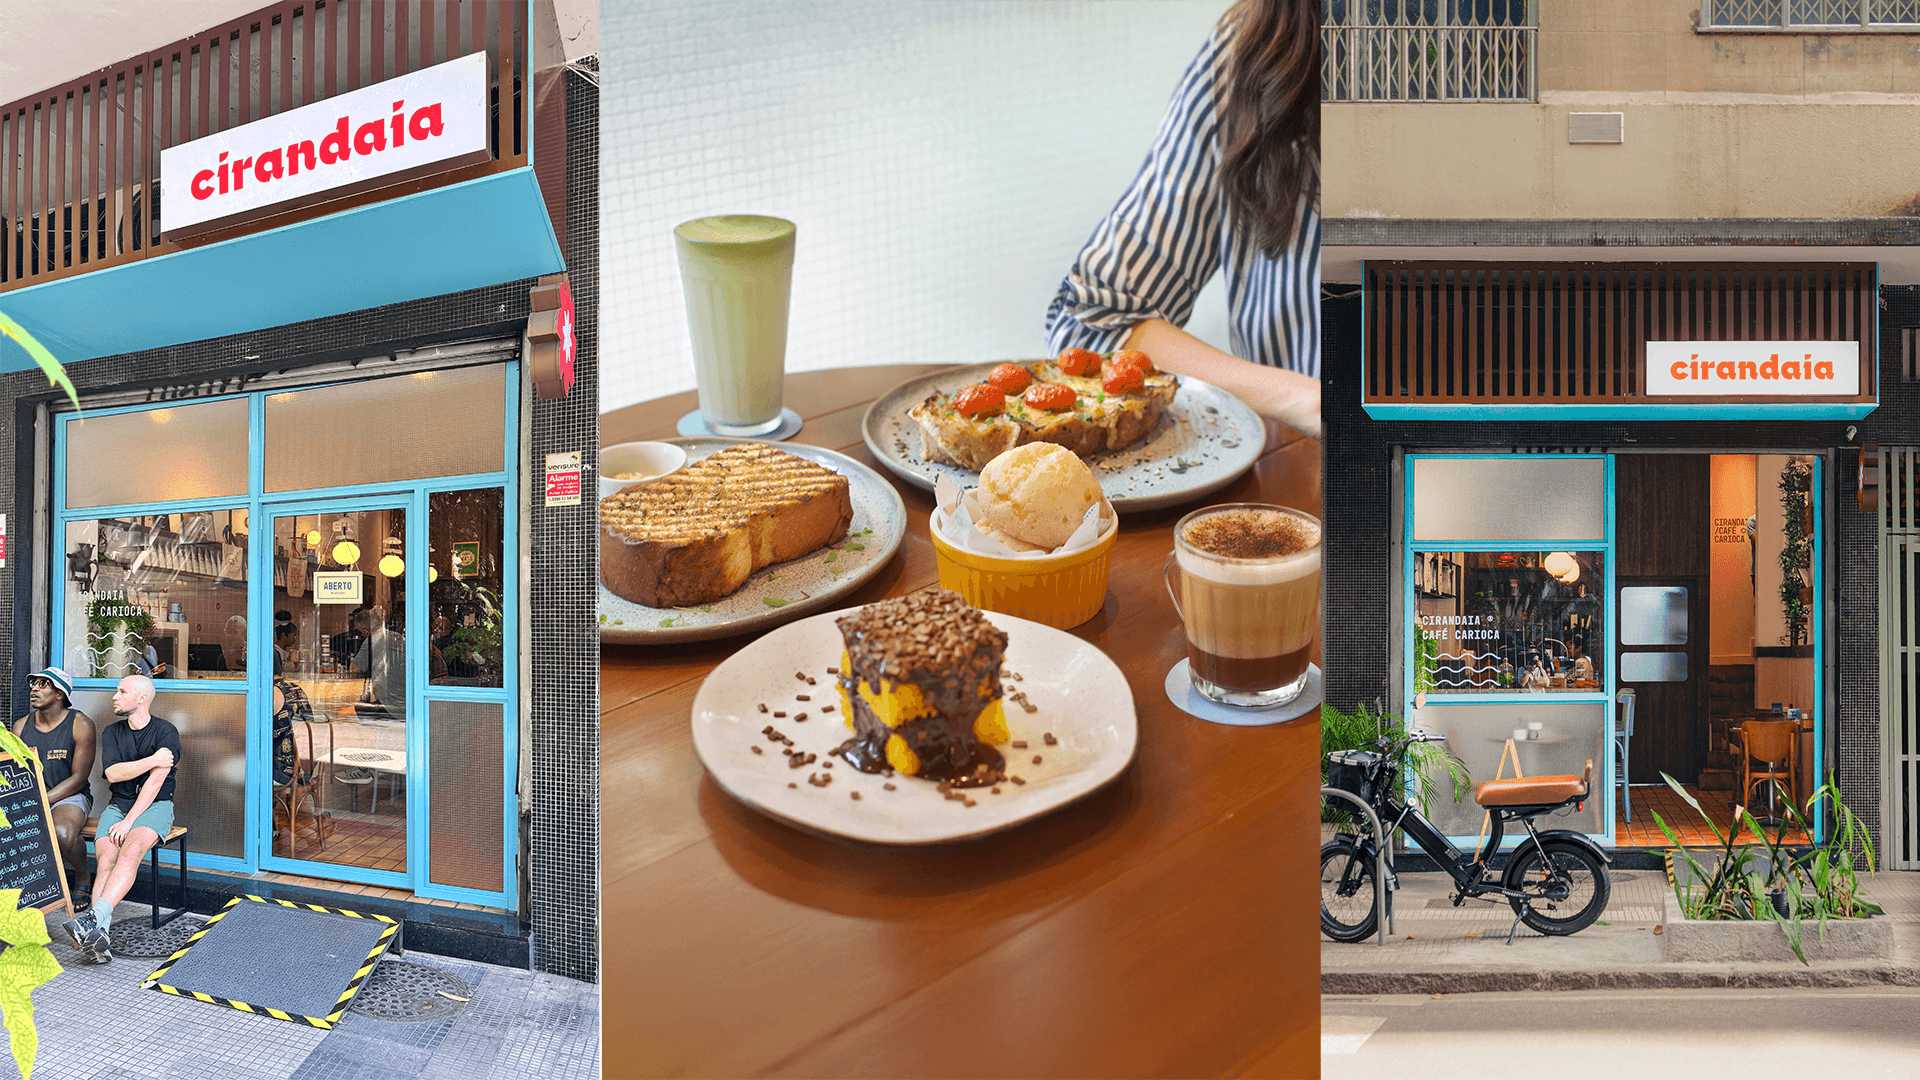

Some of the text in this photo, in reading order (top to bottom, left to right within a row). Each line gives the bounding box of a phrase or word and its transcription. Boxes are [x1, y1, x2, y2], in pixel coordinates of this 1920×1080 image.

[190, 99, 445, 201] cirandaia
[1670, 353, 1834, 380] cirandaia
[1714, 534, 1745, 543] CARIOCA
[324, 582, 352, 590] ABERTO
[100, 606, 142, 616] CARIOCA
[1422, 615, 1481, 626] CIRANDAIA
[1422, 627, 1500, 640] CAFÉ CARIOCA
[14, 813, 40, 827] mexidos
[15, 827, 41, 840] tapioca
[9, 841, 39, 856] de lombo
[20, 860, 29, 868] de
[30, 853, 48, 864] coco
[10, 868, 46, 890] brigadeiro
[38, 882, 60, 898] mais!
